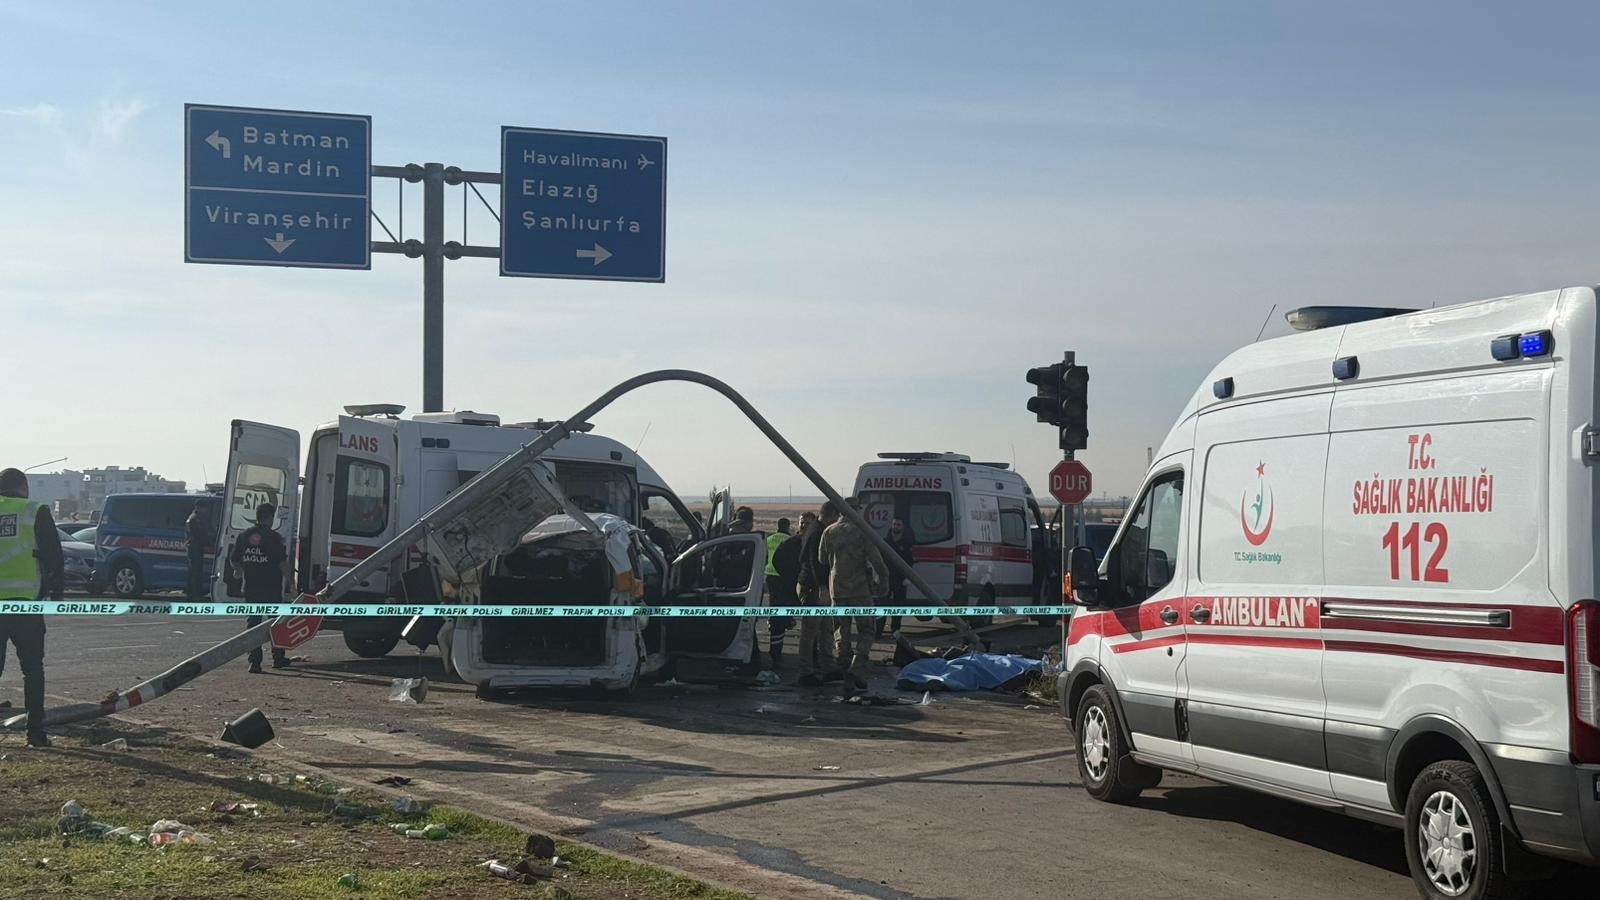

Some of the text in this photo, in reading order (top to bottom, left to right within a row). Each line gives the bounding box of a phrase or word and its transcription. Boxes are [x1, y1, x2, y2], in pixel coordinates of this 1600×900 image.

[243, 126, 349, 149] Batman
[243, 154, 341, 178] Mardin
[522, 179, 599, 203] Elazığ
[205, 205, 352, 229] Viranşehir
[522, 211, 640, 232] Şanlıurfa
[339, 432, 379, 453] LANS
[1407, 432, 1436, 470] T.C.
[864, 477, 943, 489] AMBULANS
[1053, 475, 1089, 491] DUR
[1352, 466, 1494, 515] SAĞLIK BAKANLIĞI
[871, 509, 889, 521] 112
[148, 538, 189, 550] JANDARM
[1382, 521, 1450, 583] 112
[286, 615, 310, 645] UR
